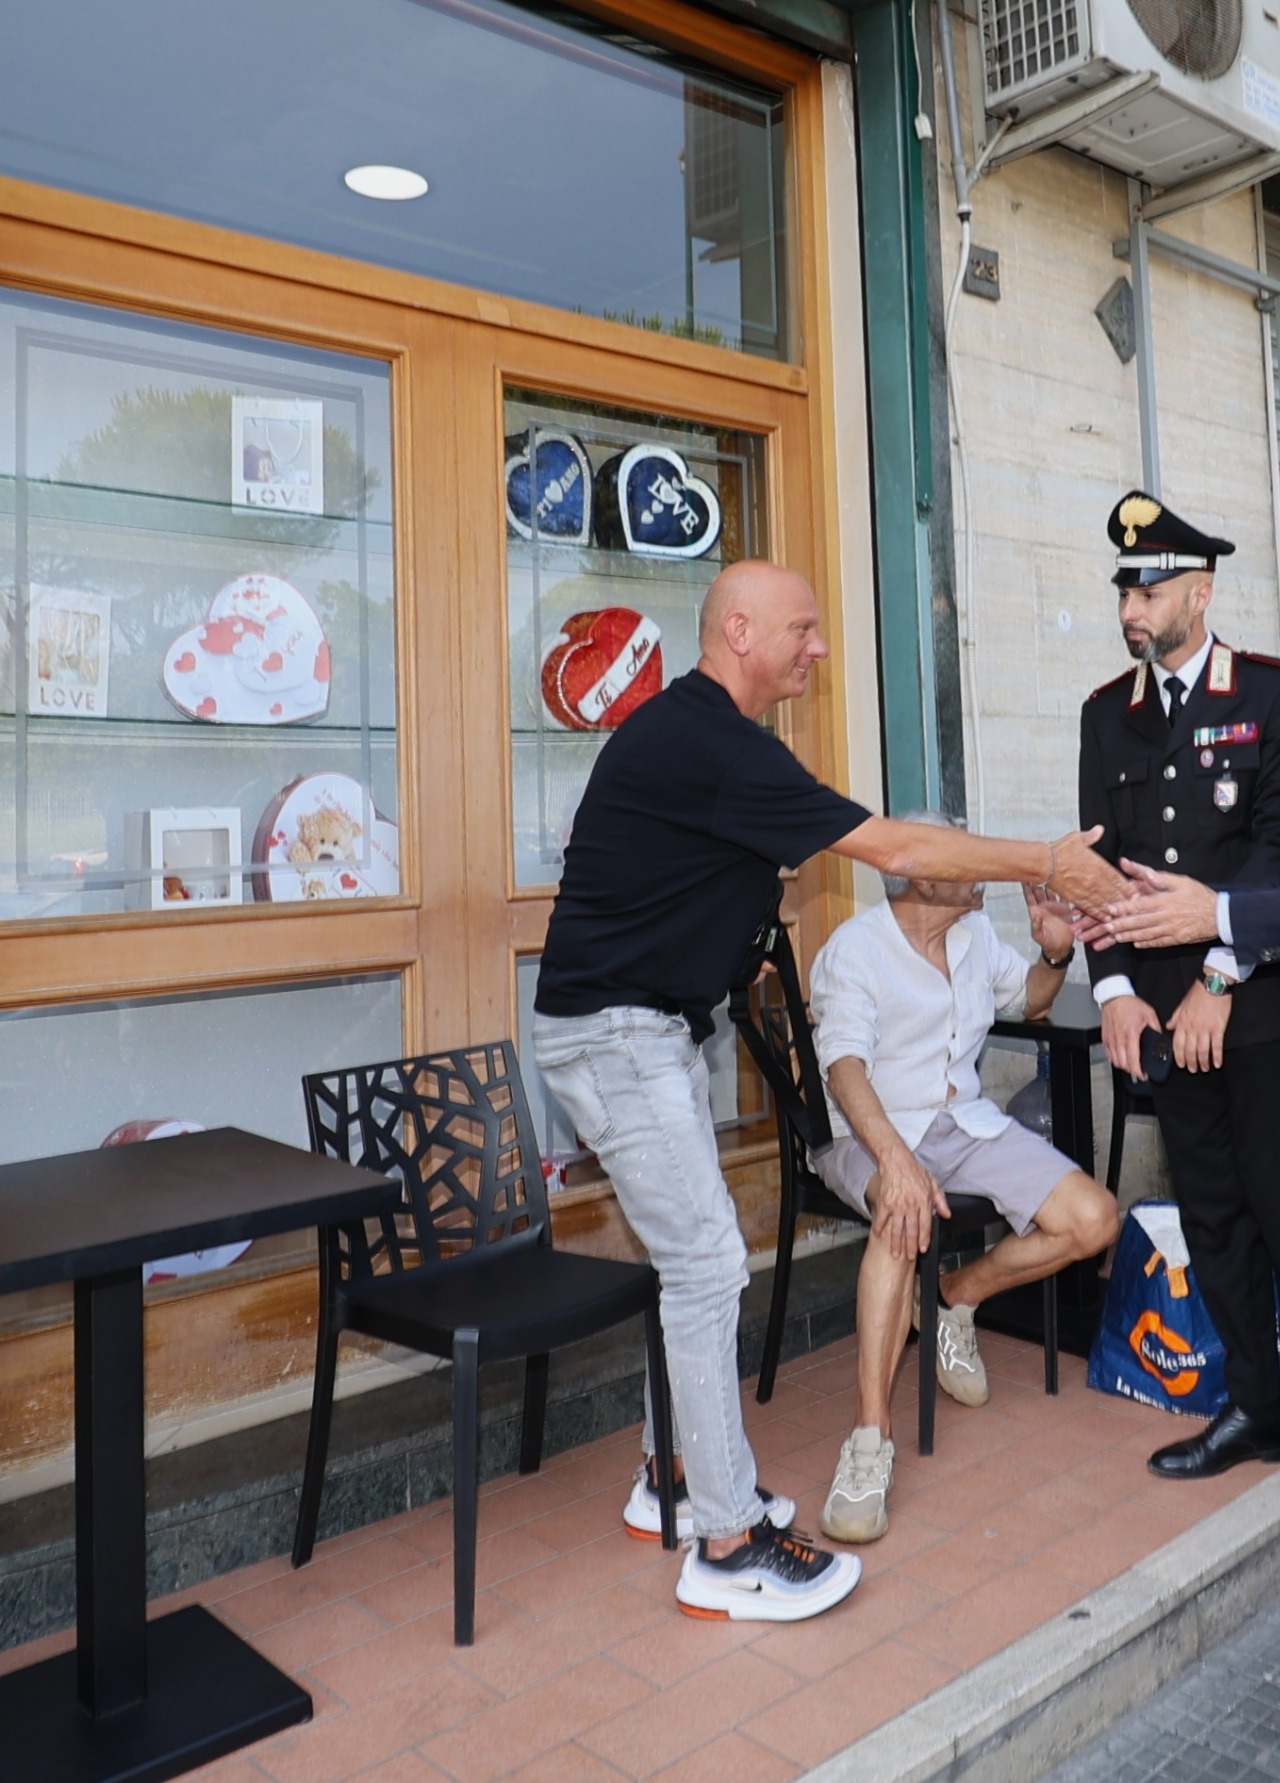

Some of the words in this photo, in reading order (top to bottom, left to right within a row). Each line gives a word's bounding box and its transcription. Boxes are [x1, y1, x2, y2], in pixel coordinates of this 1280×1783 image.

[245, 487, 310, 507] LOVE
[595, 681, 612, 710] Ti
[626, 637, 650, 677] Amo
[39, 686, 97, 711] LOVE
[1116, 1375, 1131, 1396] La
